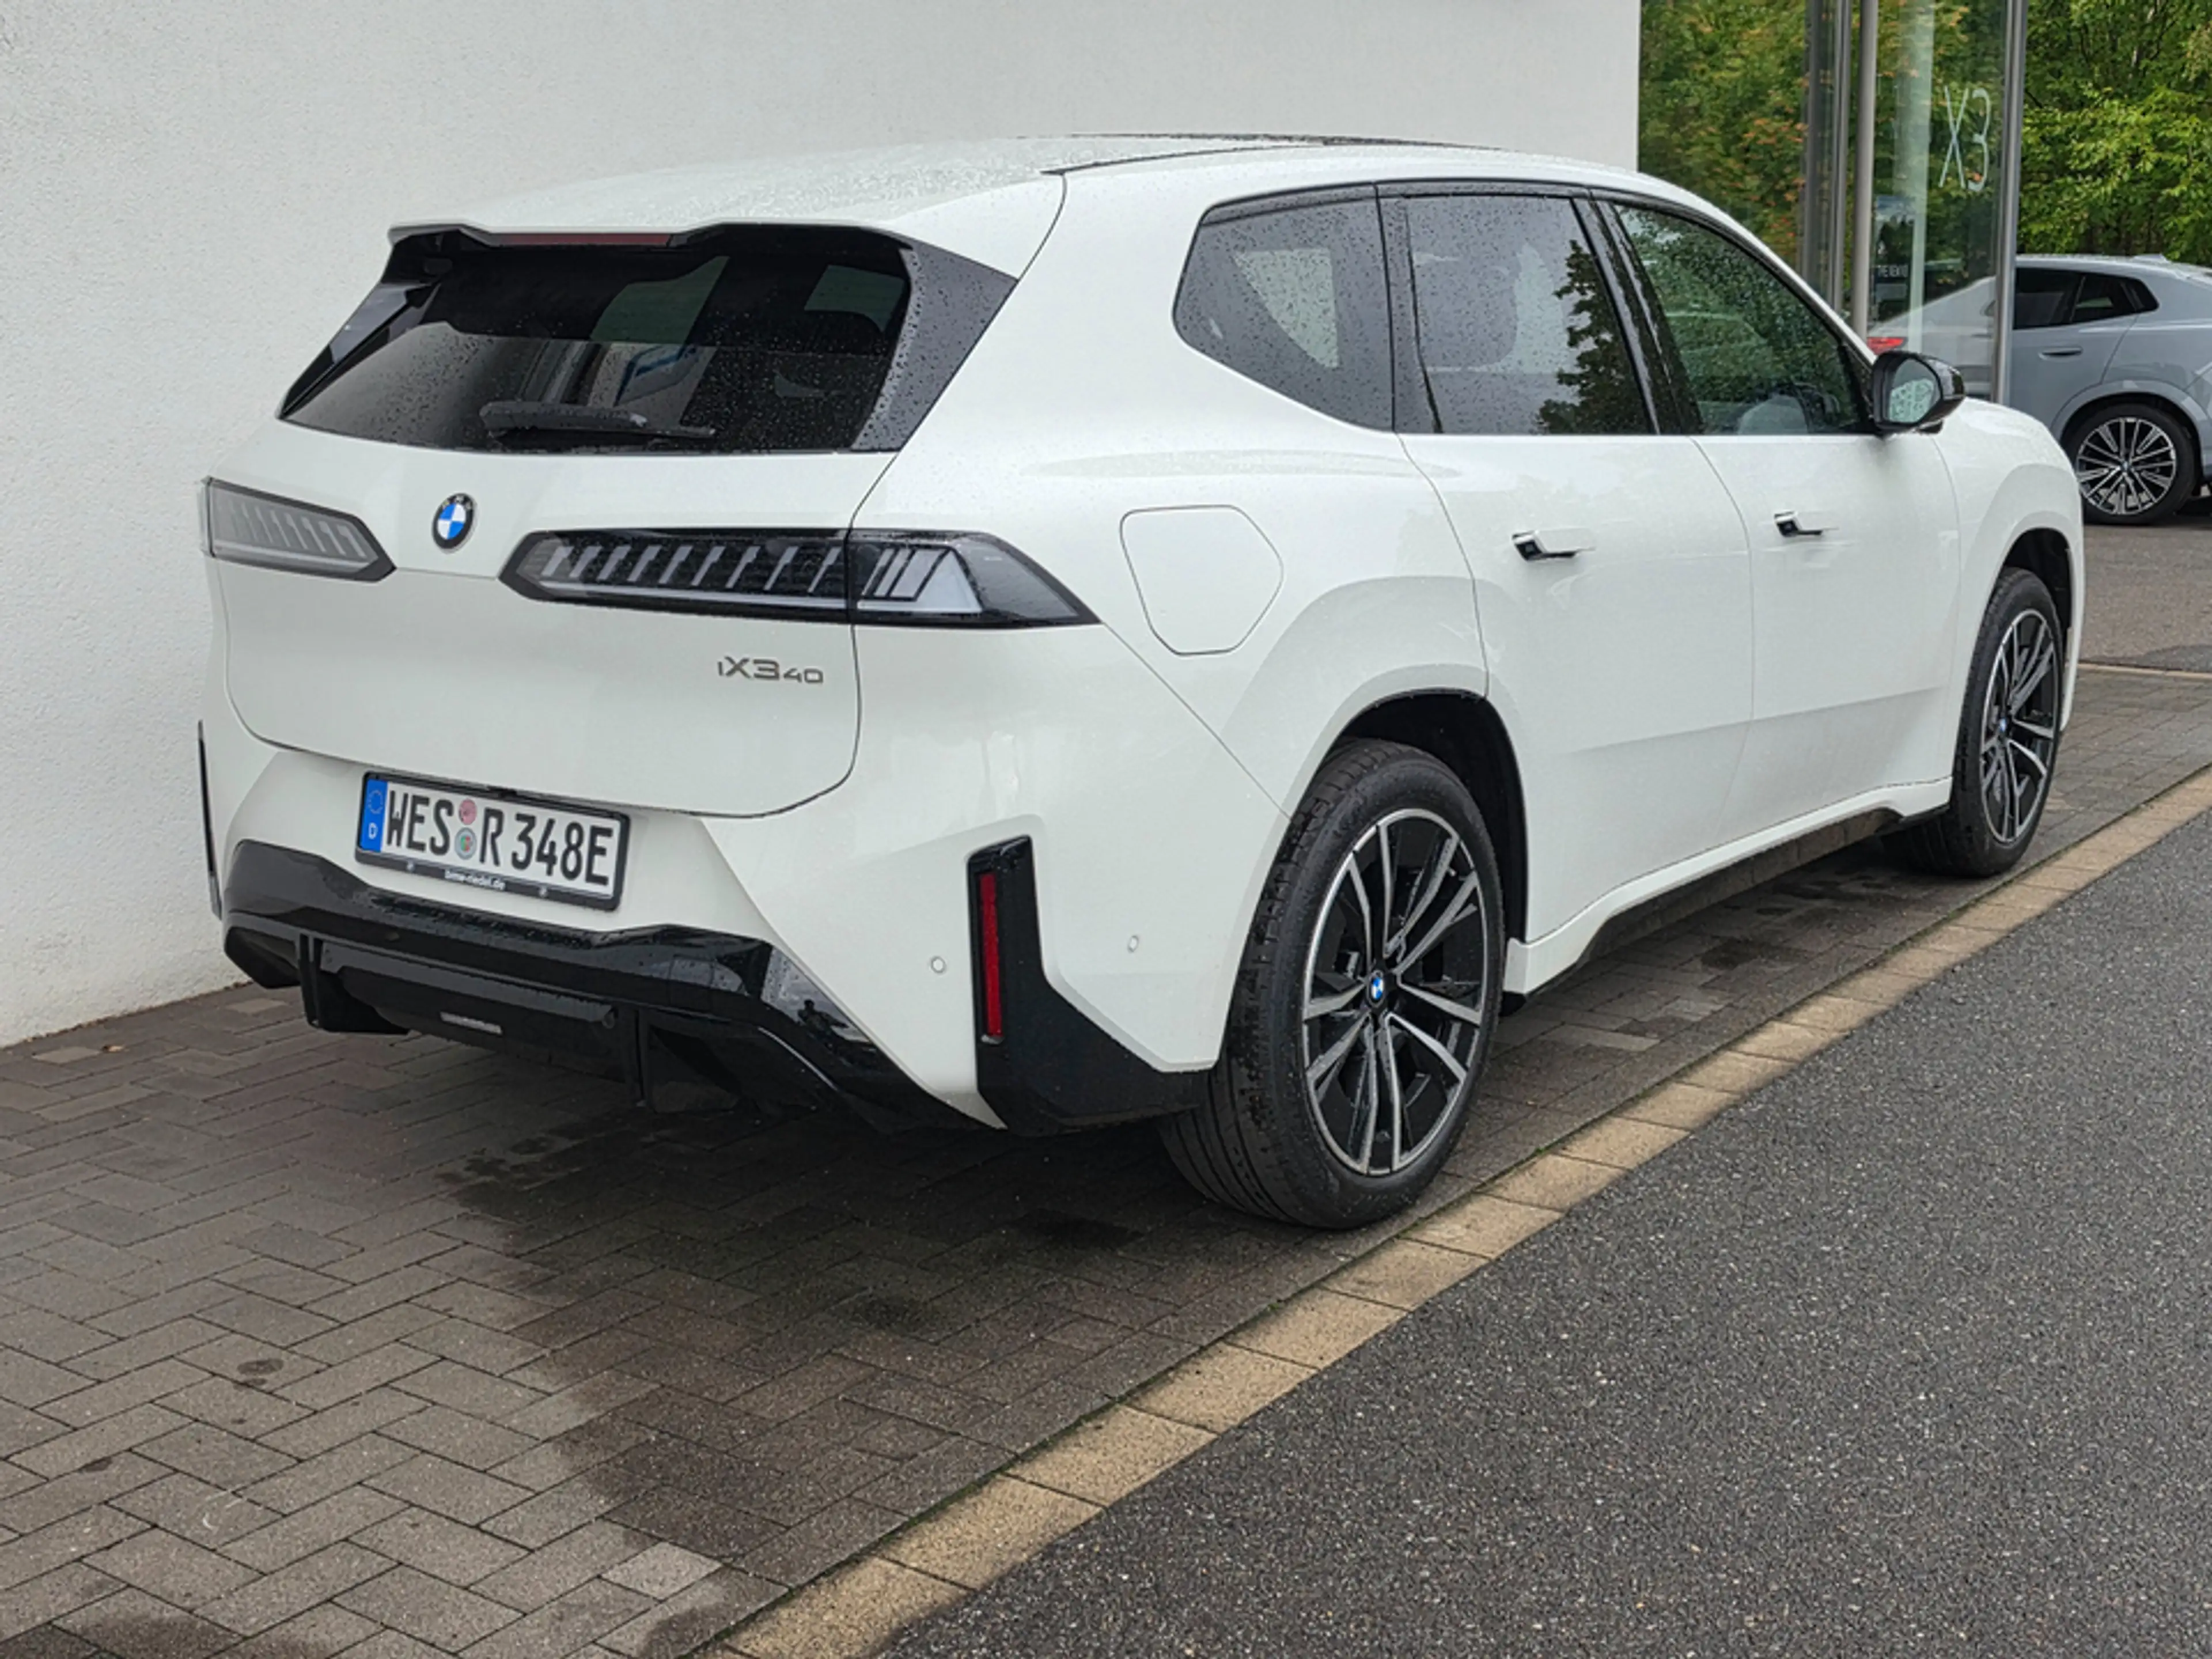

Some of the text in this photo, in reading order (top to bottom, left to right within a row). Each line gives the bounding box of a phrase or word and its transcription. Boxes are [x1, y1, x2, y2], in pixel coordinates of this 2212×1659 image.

[1938, 85, 1992, 192] X3
[387, 790, 613, 887] WES R 348E
